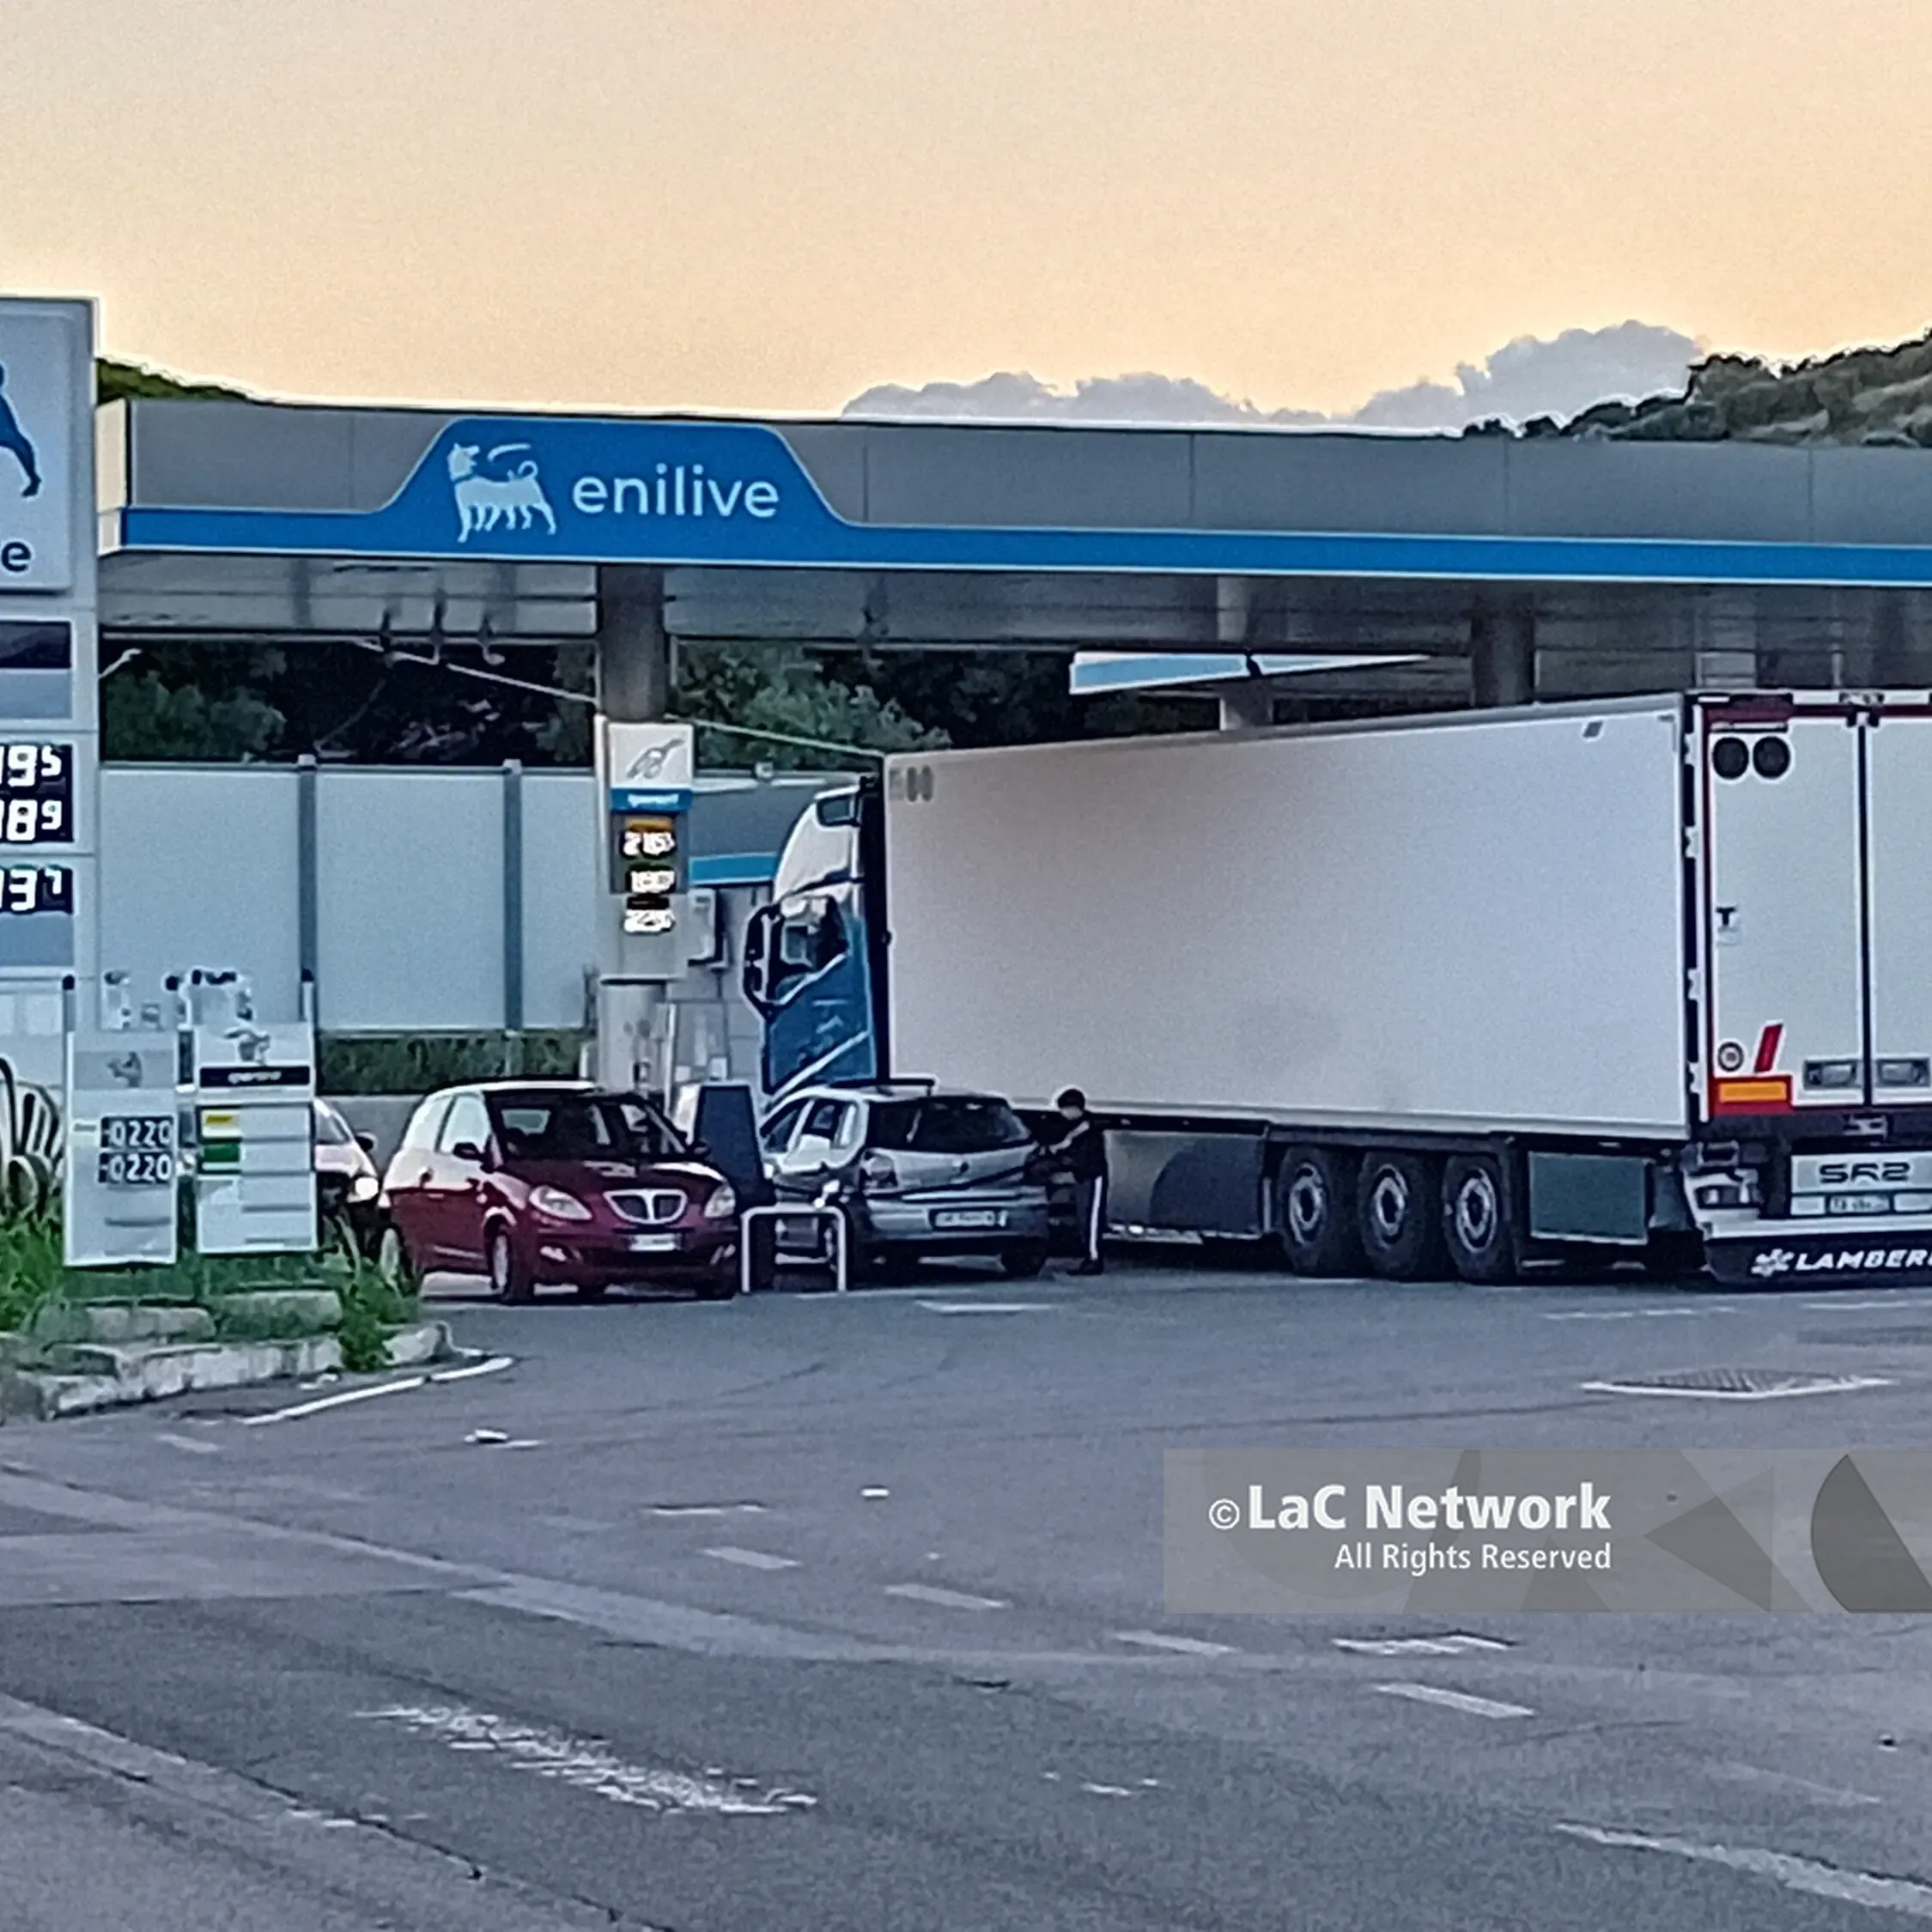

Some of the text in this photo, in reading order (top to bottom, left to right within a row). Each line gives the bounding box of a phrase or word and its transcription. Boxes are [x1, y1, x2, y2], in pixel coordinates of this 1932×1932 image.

[574, 464, 780, 518] enilive
[0, 744, 62, 787] 95
[0, 799, 62, 841] 89
[0, 868, 62, 911] 37
[1820, 1162, 1911, 1184] SR2
[1795, 1249, 1932, 1271] LAMBER
